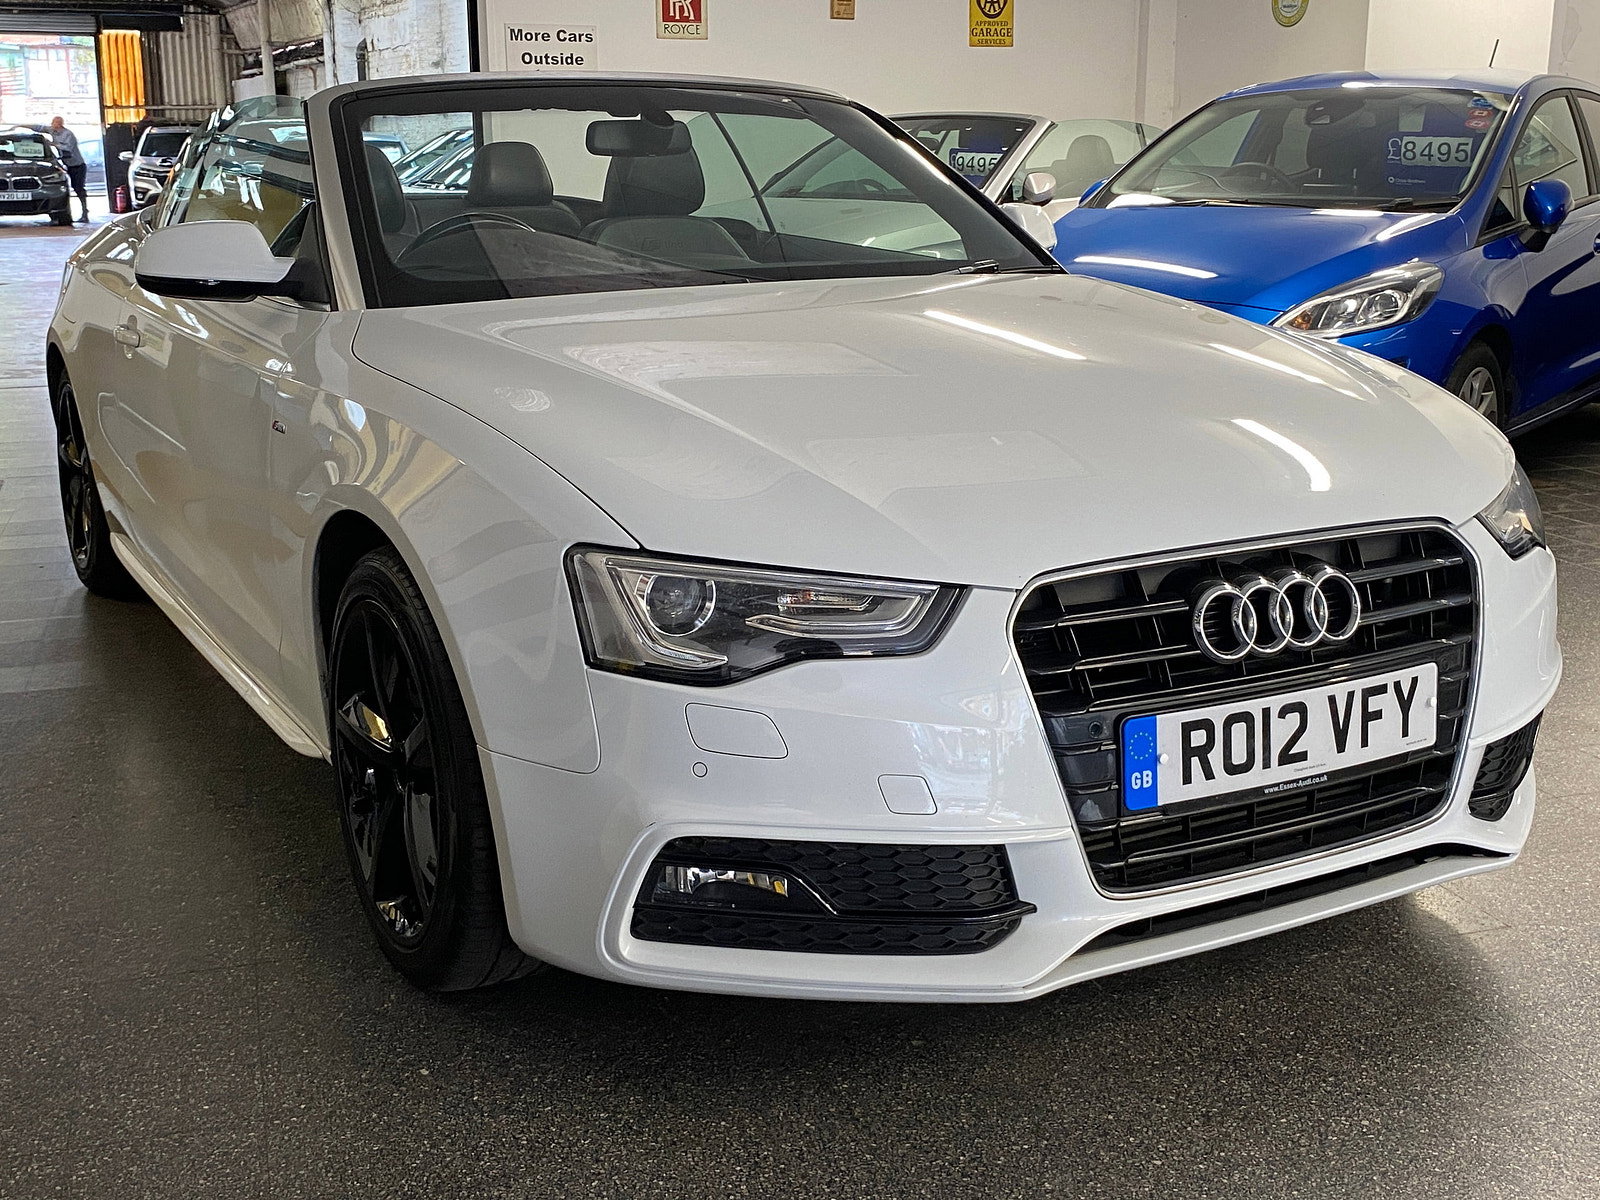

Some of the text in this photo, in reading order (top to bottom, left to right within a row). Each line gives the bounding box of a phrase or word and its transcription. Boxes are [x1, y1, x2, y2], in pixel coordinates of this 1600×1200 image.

[509, 28, 594, 43] More Cars
[663, 24, 701, 35] ROYCE
[971, 27, 1012, 37] GARAGE
[521, 52, 584, 66] Outside
[1180, 675, 1419, 786] RO12 VFY
[1131, 769, 1153, 790] GB
